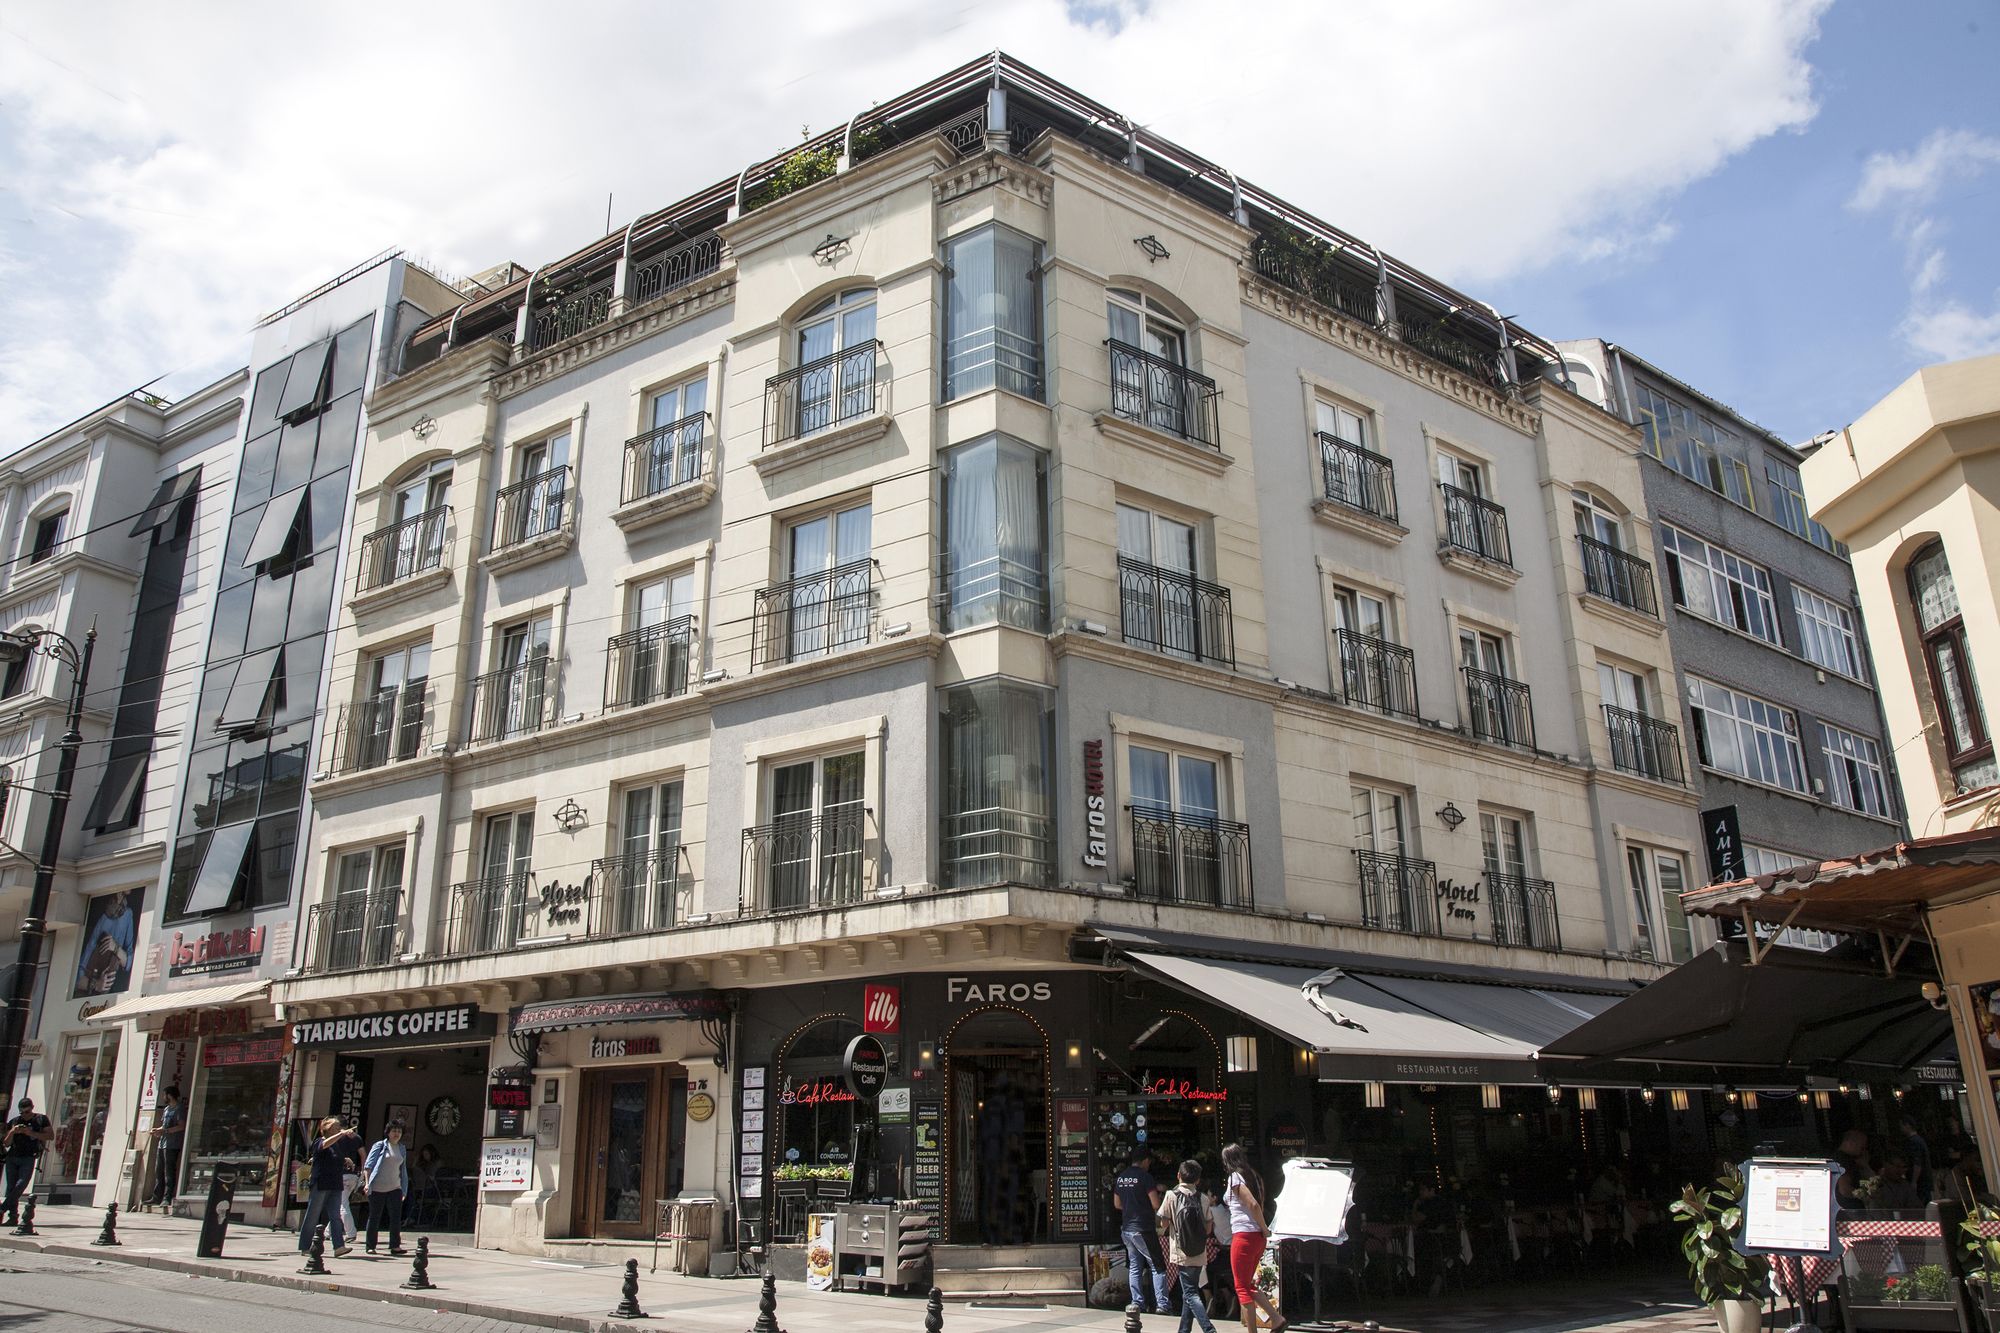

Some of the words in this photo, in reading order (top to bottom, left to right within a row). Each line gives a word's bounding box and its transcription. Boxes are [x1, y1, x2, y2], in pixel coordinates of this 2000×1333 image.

[540, 875, 592, 908] Hotel
[1438, 878, 1480, 902] Hotel
[1447, 902, 1476, 921] Faros
[225, 960, 247, 970] GAZETE
[947, 977, 1052, 1003] FAROS
[868, 992, 898, 1030] illy
[291, 1016, 394, 1045] STARBUCKS
[397, 1008, 470, 1036] COFFEE
[852, 1062, 885, 1073] Restaurant
[1397, 1064, 1451, 1075] RESTAURANT
[1458, 1066, 1480, 1075] CAFE
[698, 1080, 708, 1090] 76
[861, 1075, 877, 1085] Cafe
[797, 1083, 819, 1108] Cafe
[1179, 1081, 1228, 1101] Restaurant
[485, 1167, 502, 1177] LIVE
[916, 1165, 939, 1174] BEER
[1117, 1176, 1138, 1185] FAROS
[917, 1188, 939, 1196] WINE
[1061, 1190, 1088, 1198] MEZES
